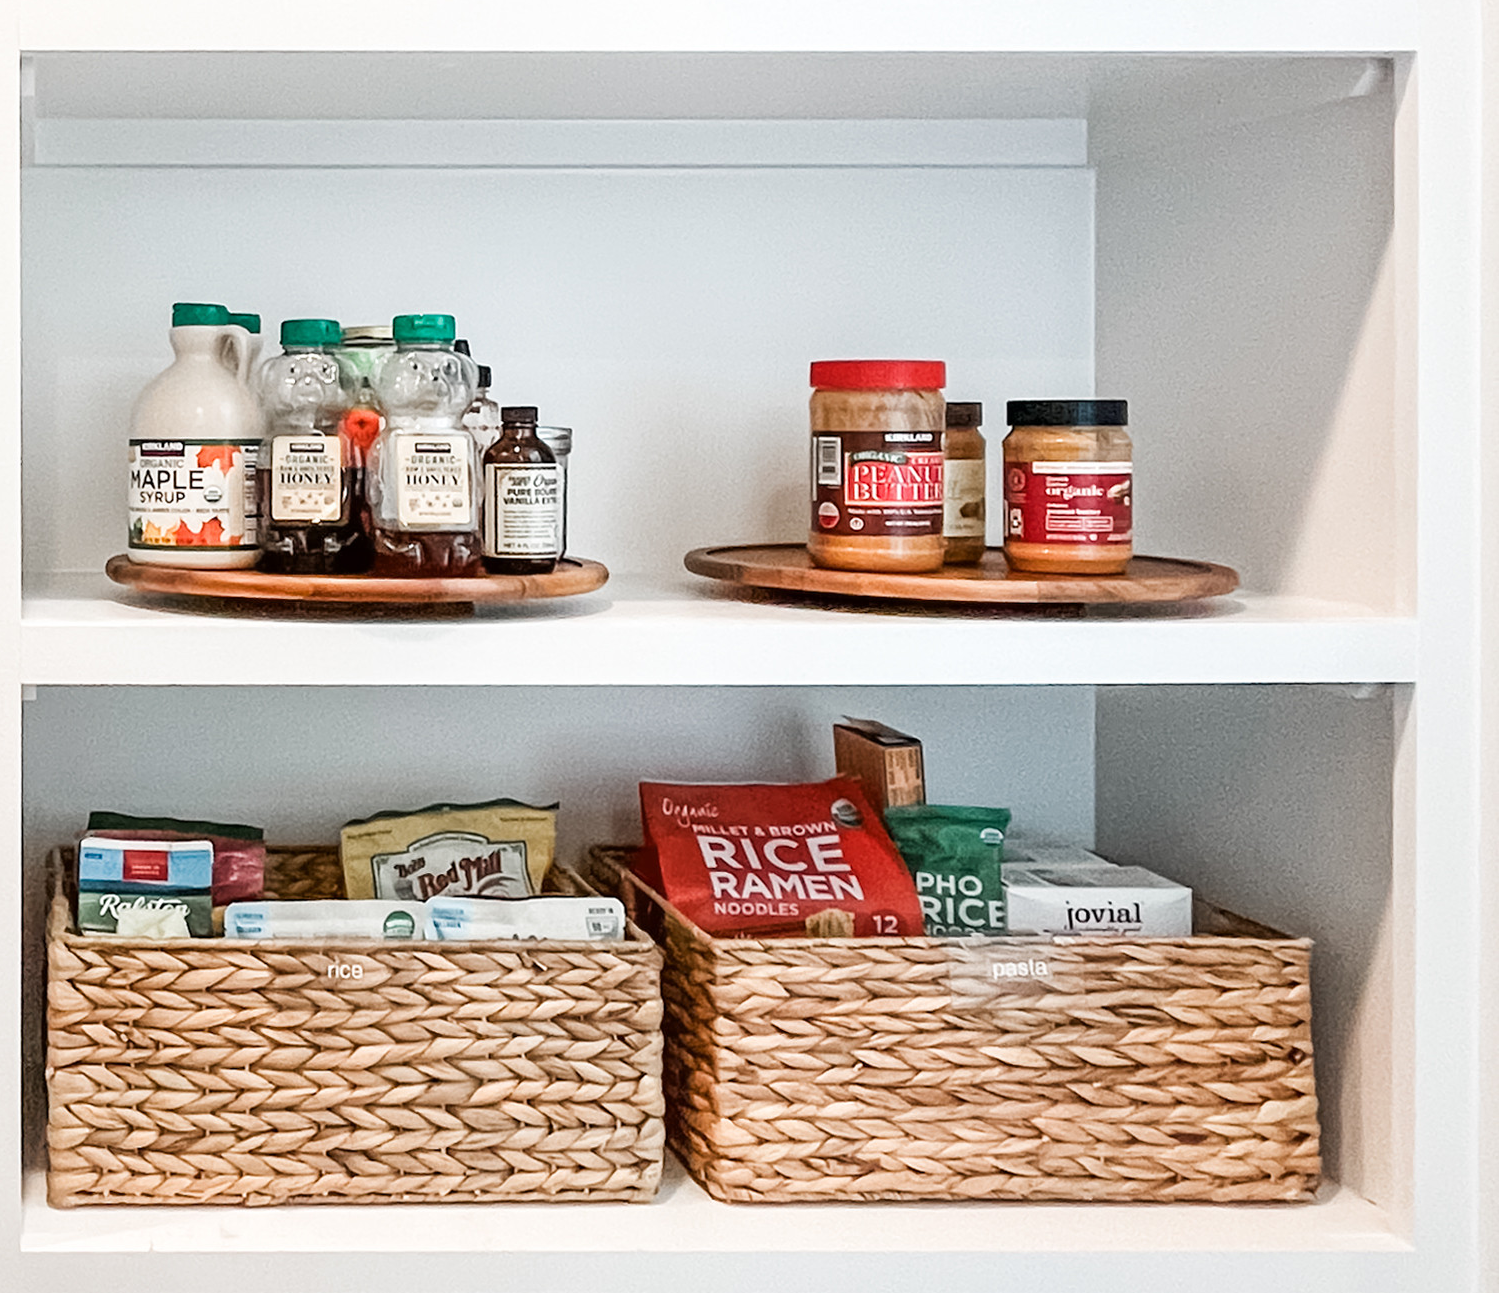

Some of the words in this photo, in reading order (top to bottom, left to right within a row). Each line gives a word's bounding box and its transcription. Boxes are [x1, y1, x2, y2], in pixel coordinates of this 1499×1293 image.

[140, 459, 185, 468] ORGANIC
[285, 455, 329, 464] ORGANIC
[411, 455, 456, 464] ORGANIC
[130, 470, 205, 490] MAPLE
[280, 473, 331, 484] HONEY
[407, 474, 459, 485] HONEY
[140, 491, 186, 504] SYRUP
[1046, 485, 1104, 500] organic
[662, 797, 721, 828] Organic
[692, 824, 749, 837] MILLET
[754, 825, 766, 837] &
[768, 821, 838, 837] BROWN
[696, 835, 852, 872] RICE
[418, 860, 459, 901] Red
[459, 849, 503, 891] Mill
[916, 872, 983, 897] PHO
[709, 871, 865, 901] RAMEN
[714, 902, 800, 916] NOODLES
[918, 896, 1006, 928] RICE
[1065, 900, 1143, 932] jovial
[873, 915, 899, 934] 12
[327, 959, 363, 979] rice
[992, 958, 1048, 980] pasta
